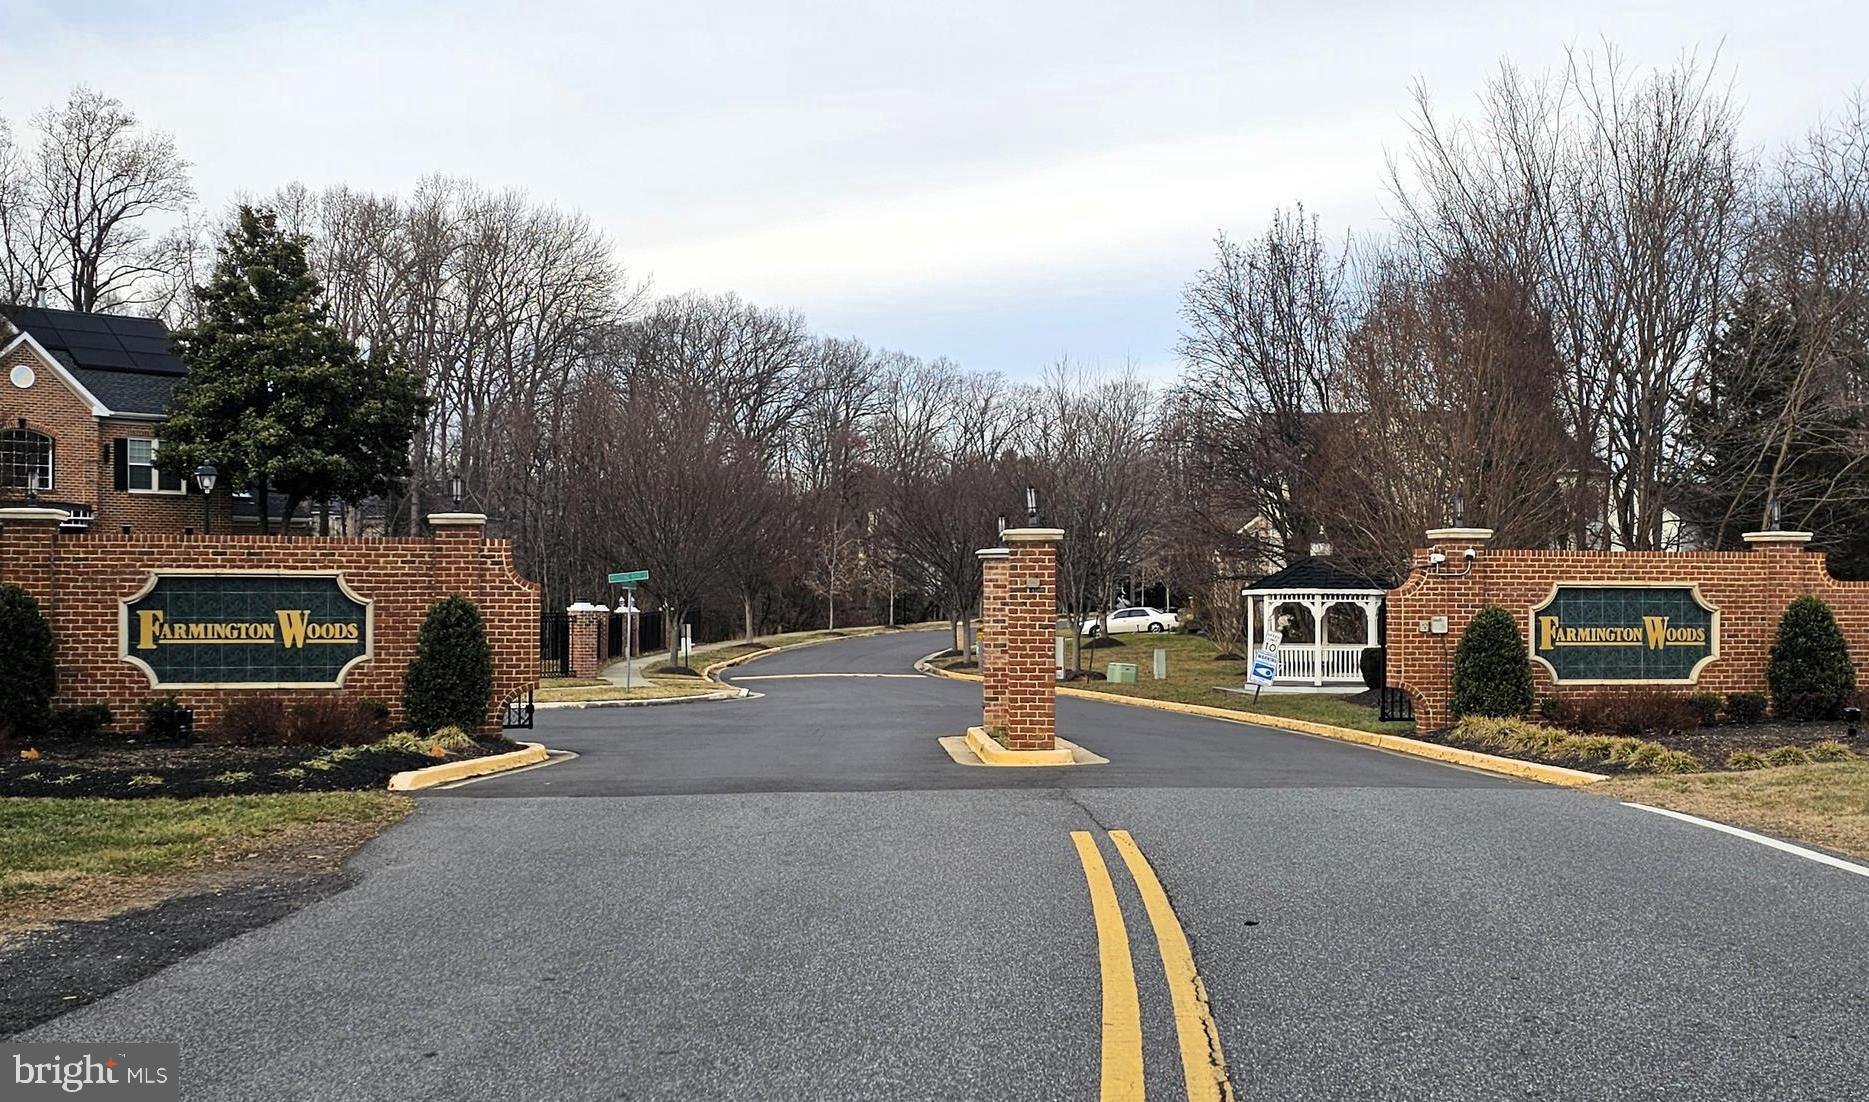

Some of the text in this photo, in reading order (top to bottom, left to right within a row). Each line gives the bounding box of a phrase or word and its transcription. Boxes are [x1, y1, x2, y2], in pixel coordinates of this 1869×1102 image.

[136, 610, 358, 649] FARMINGTON WOODS
[1538, 616, 1706, 650] FARMINGTON WOODS
[1264, 642, 1277, 652] 10
